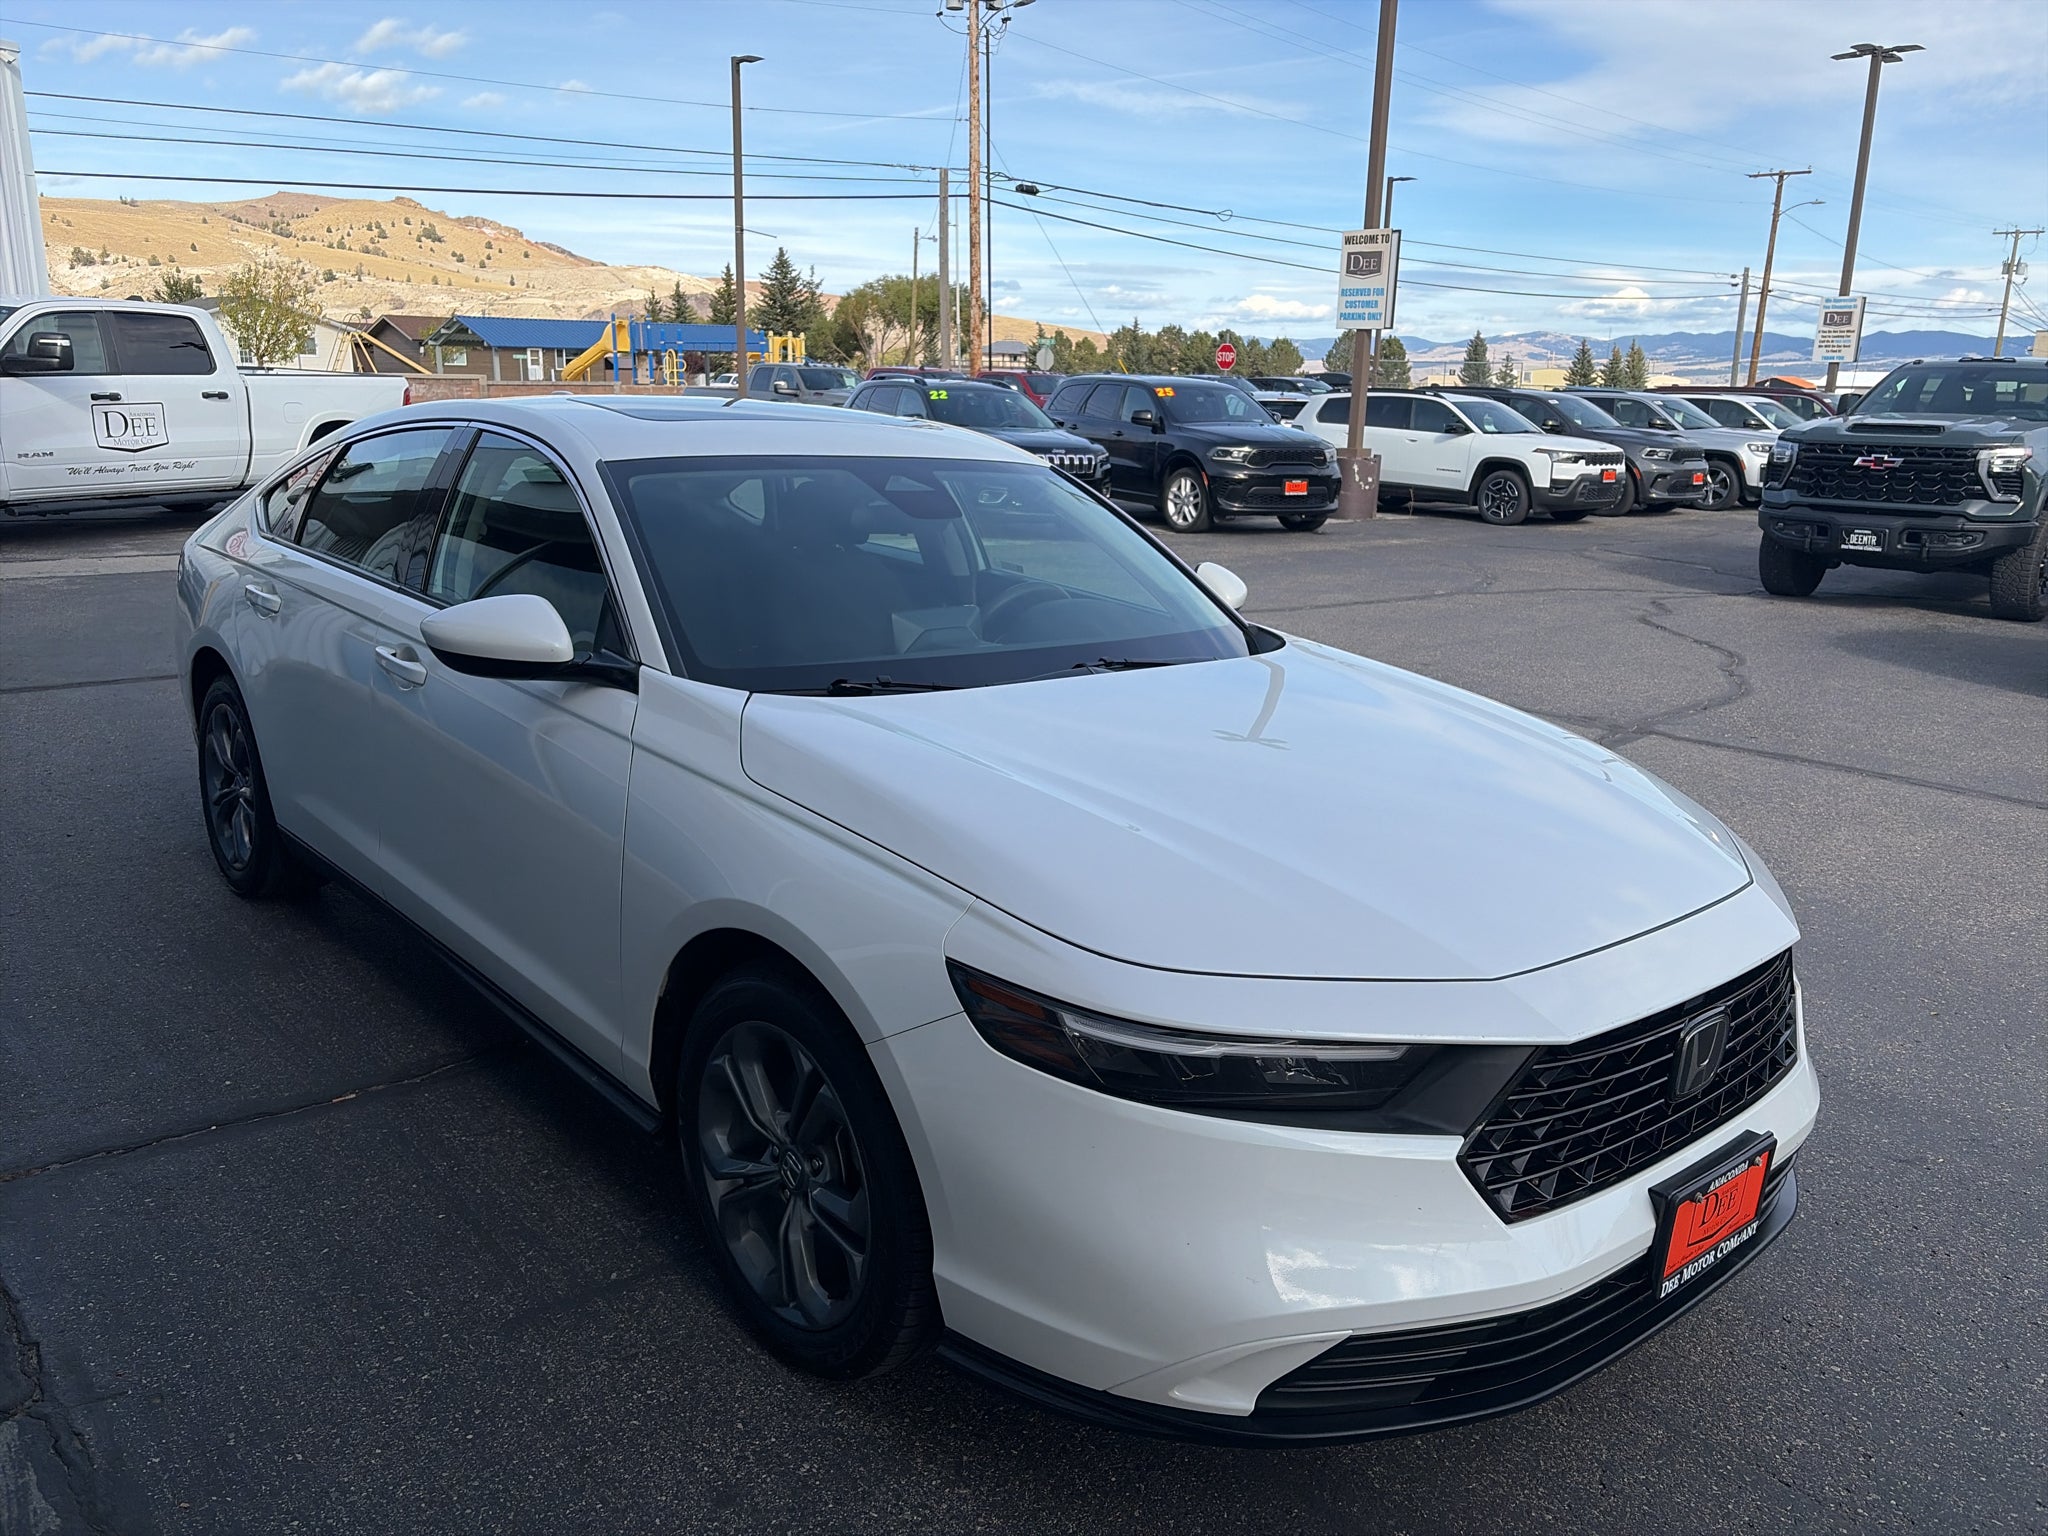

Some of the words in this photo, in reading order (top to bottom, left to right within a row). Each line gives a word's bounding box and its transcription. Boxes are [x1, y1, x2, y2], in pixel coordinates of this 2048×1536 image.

[1344, 234, 1379, 245] WELCOME
[1381, 233, 1390, 244] TO
[1349, 254, 1378, 271] DEE
[1341, 288, 1371, 297] RESERVED
[1372, 287, 1385, 296] FOR
[1345, 300, 1378, 309] CUSTOMER
[1340, 312, 1366, 321] PARKING
[1367, 312, 1383, 320] ONLY
[1217, 351, 1235, 362] STOP
[929, 390, 948, 400] 22
[1155, 387, 1175, 397] 25
[101, 410, 159, 439] DEE
[17, 451, 54, 459] RAM
[92, 465, 125, 475] Always
[128, 463, 151, 473] Treat
[153, 462, 170, 472] You
[1698, 1187, 1739, 1228] DEE
[1660, 1273, 1681, 1299] DEE
[1680, 1250, 1716, 1284] MOTOR
[1716, 1220, 1759, 1258] COMPANY
